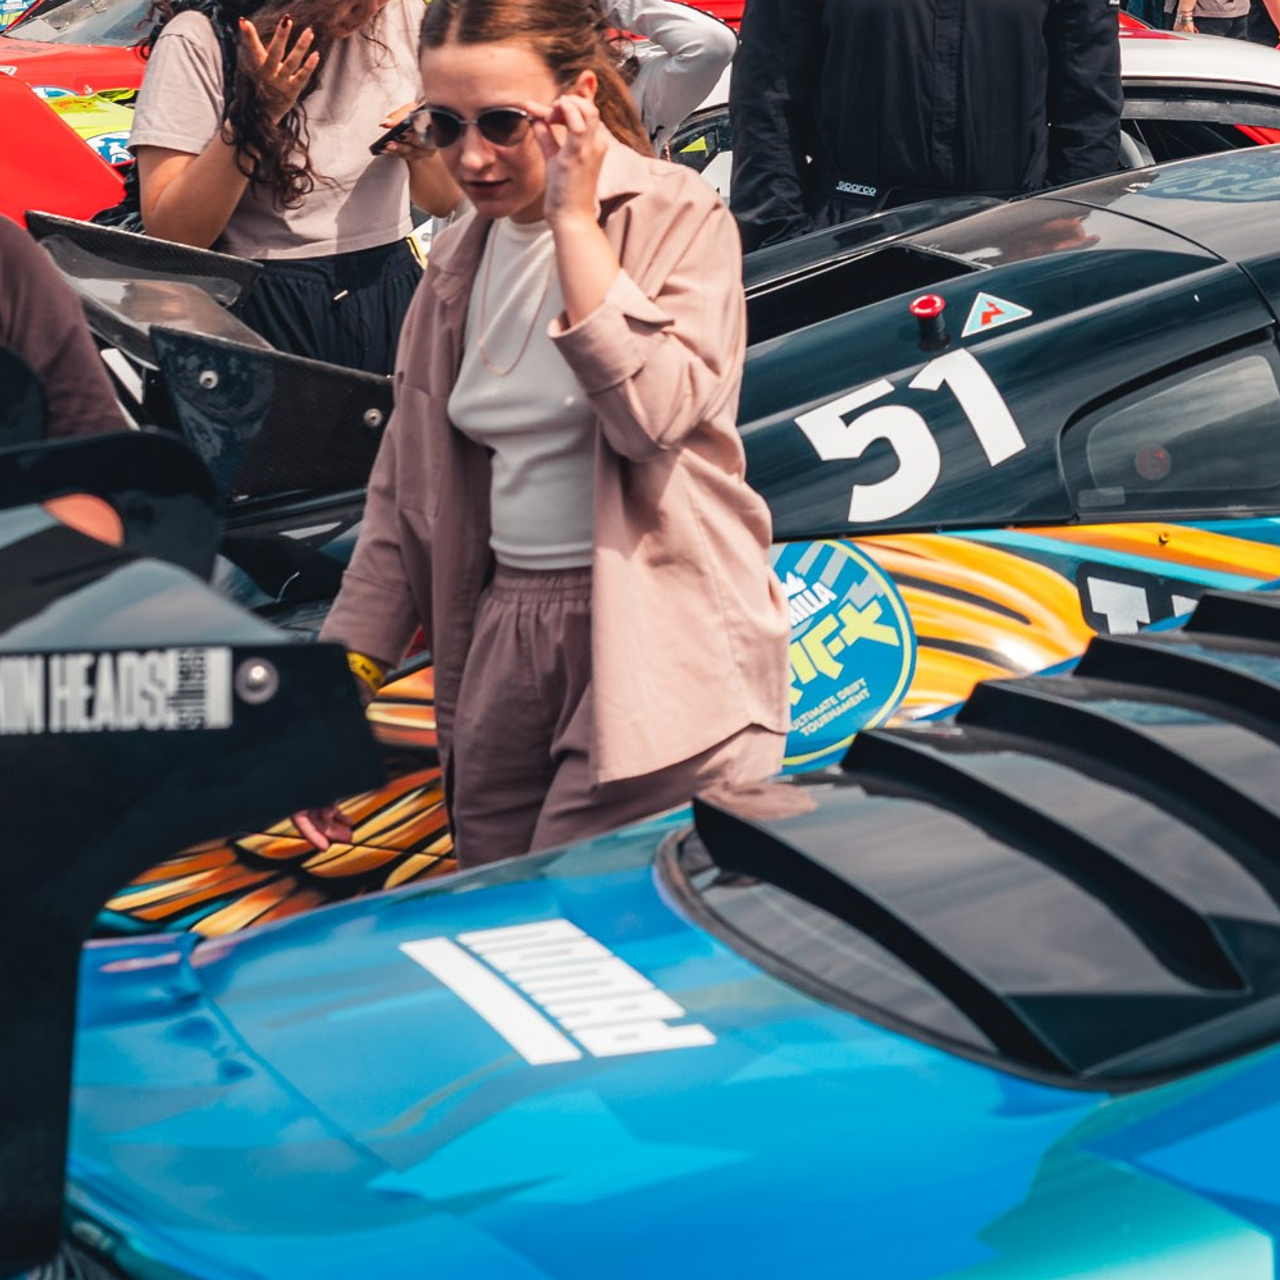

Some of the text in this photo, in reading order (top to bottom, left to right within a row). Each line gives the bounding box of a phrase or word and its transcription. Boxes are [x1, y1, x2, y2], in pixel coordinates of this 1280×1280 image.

[836, 180, 877, 198] sparco
[794, 348, 1027, 523] 51
[836, 677, 867, 701] DRIFT
[799, 687, 871, 737] TOURNAMENT
